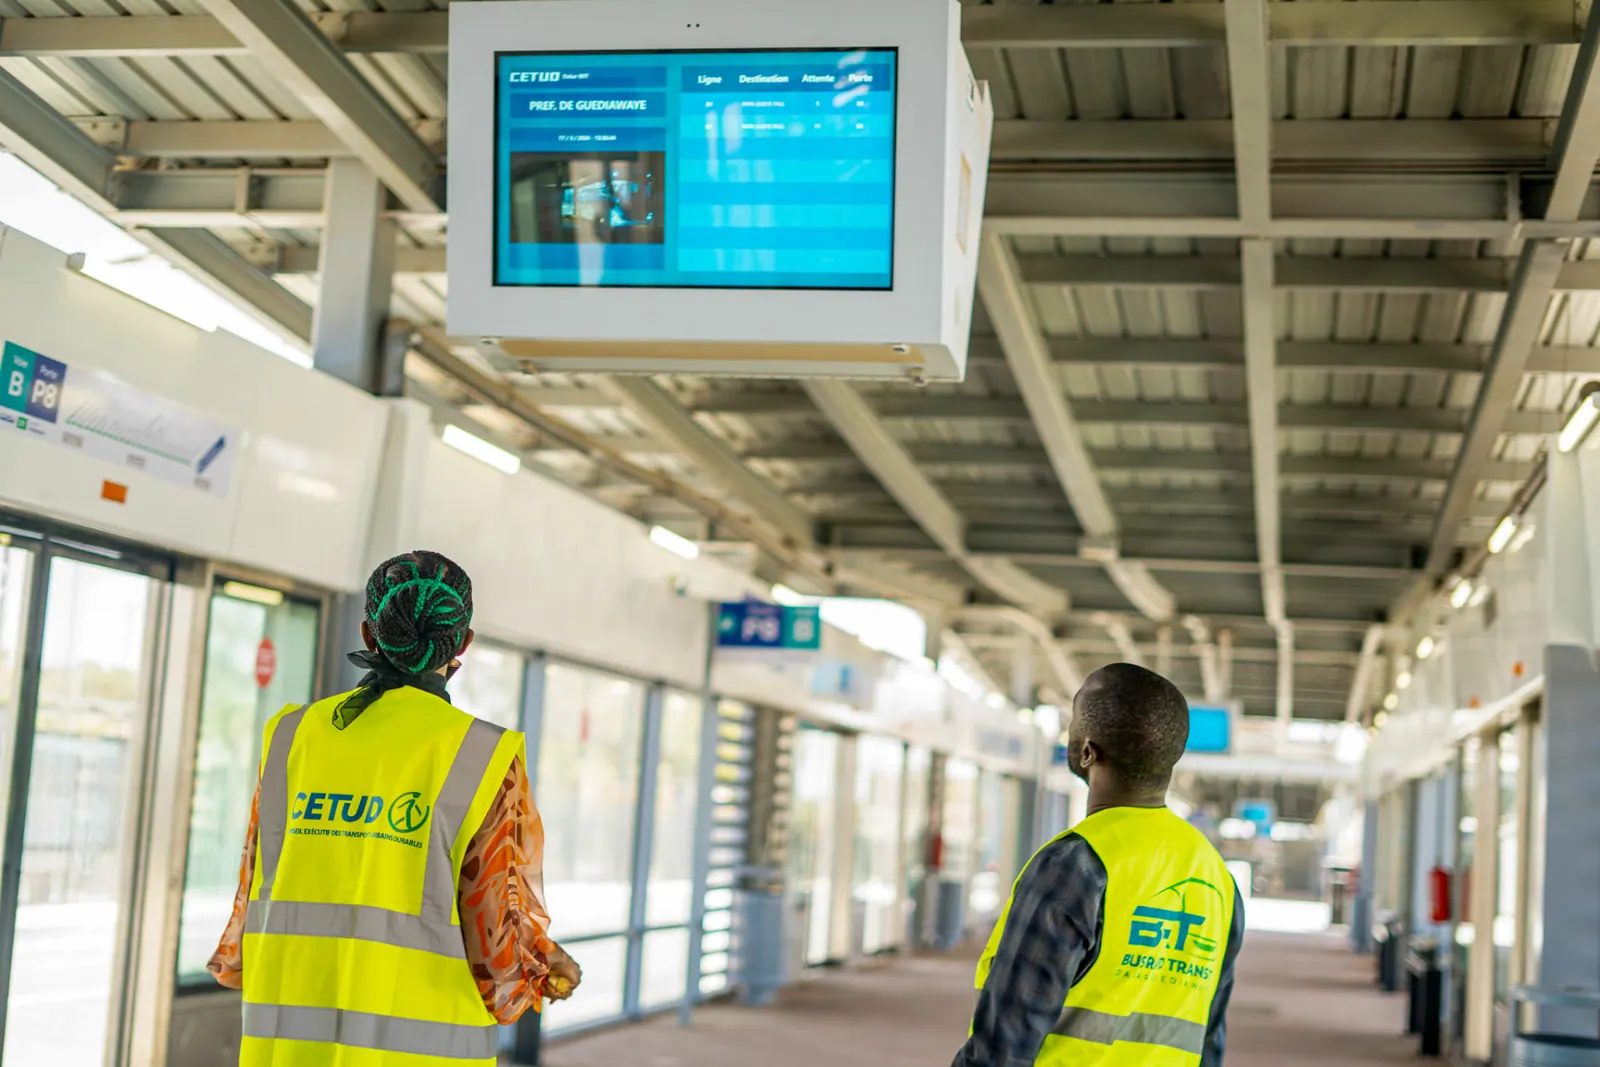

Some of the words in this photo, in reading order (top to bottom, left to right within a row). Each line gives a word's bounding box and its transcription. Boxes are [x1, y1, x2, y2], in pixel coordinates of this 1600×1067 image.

[697, 75, 723, 86] Ligne
[738, 74, 790, 84] Destination
[801, 74, 836, 83] Attente
[848, 74, 874, 83] Porte
[529, 100, 558, 112] PREF.
[558, 100, 574, 111] DE
[575, 99, 648, 111] GUEDIAWAYE
[8, 371, 24, 396] B
[32, 379, 57, 408] P8
[291, 791, 384, 824] CETUD
[394, 836, 423, 848] DURABLES
[1168, 958, 1213, 979] TRANS
